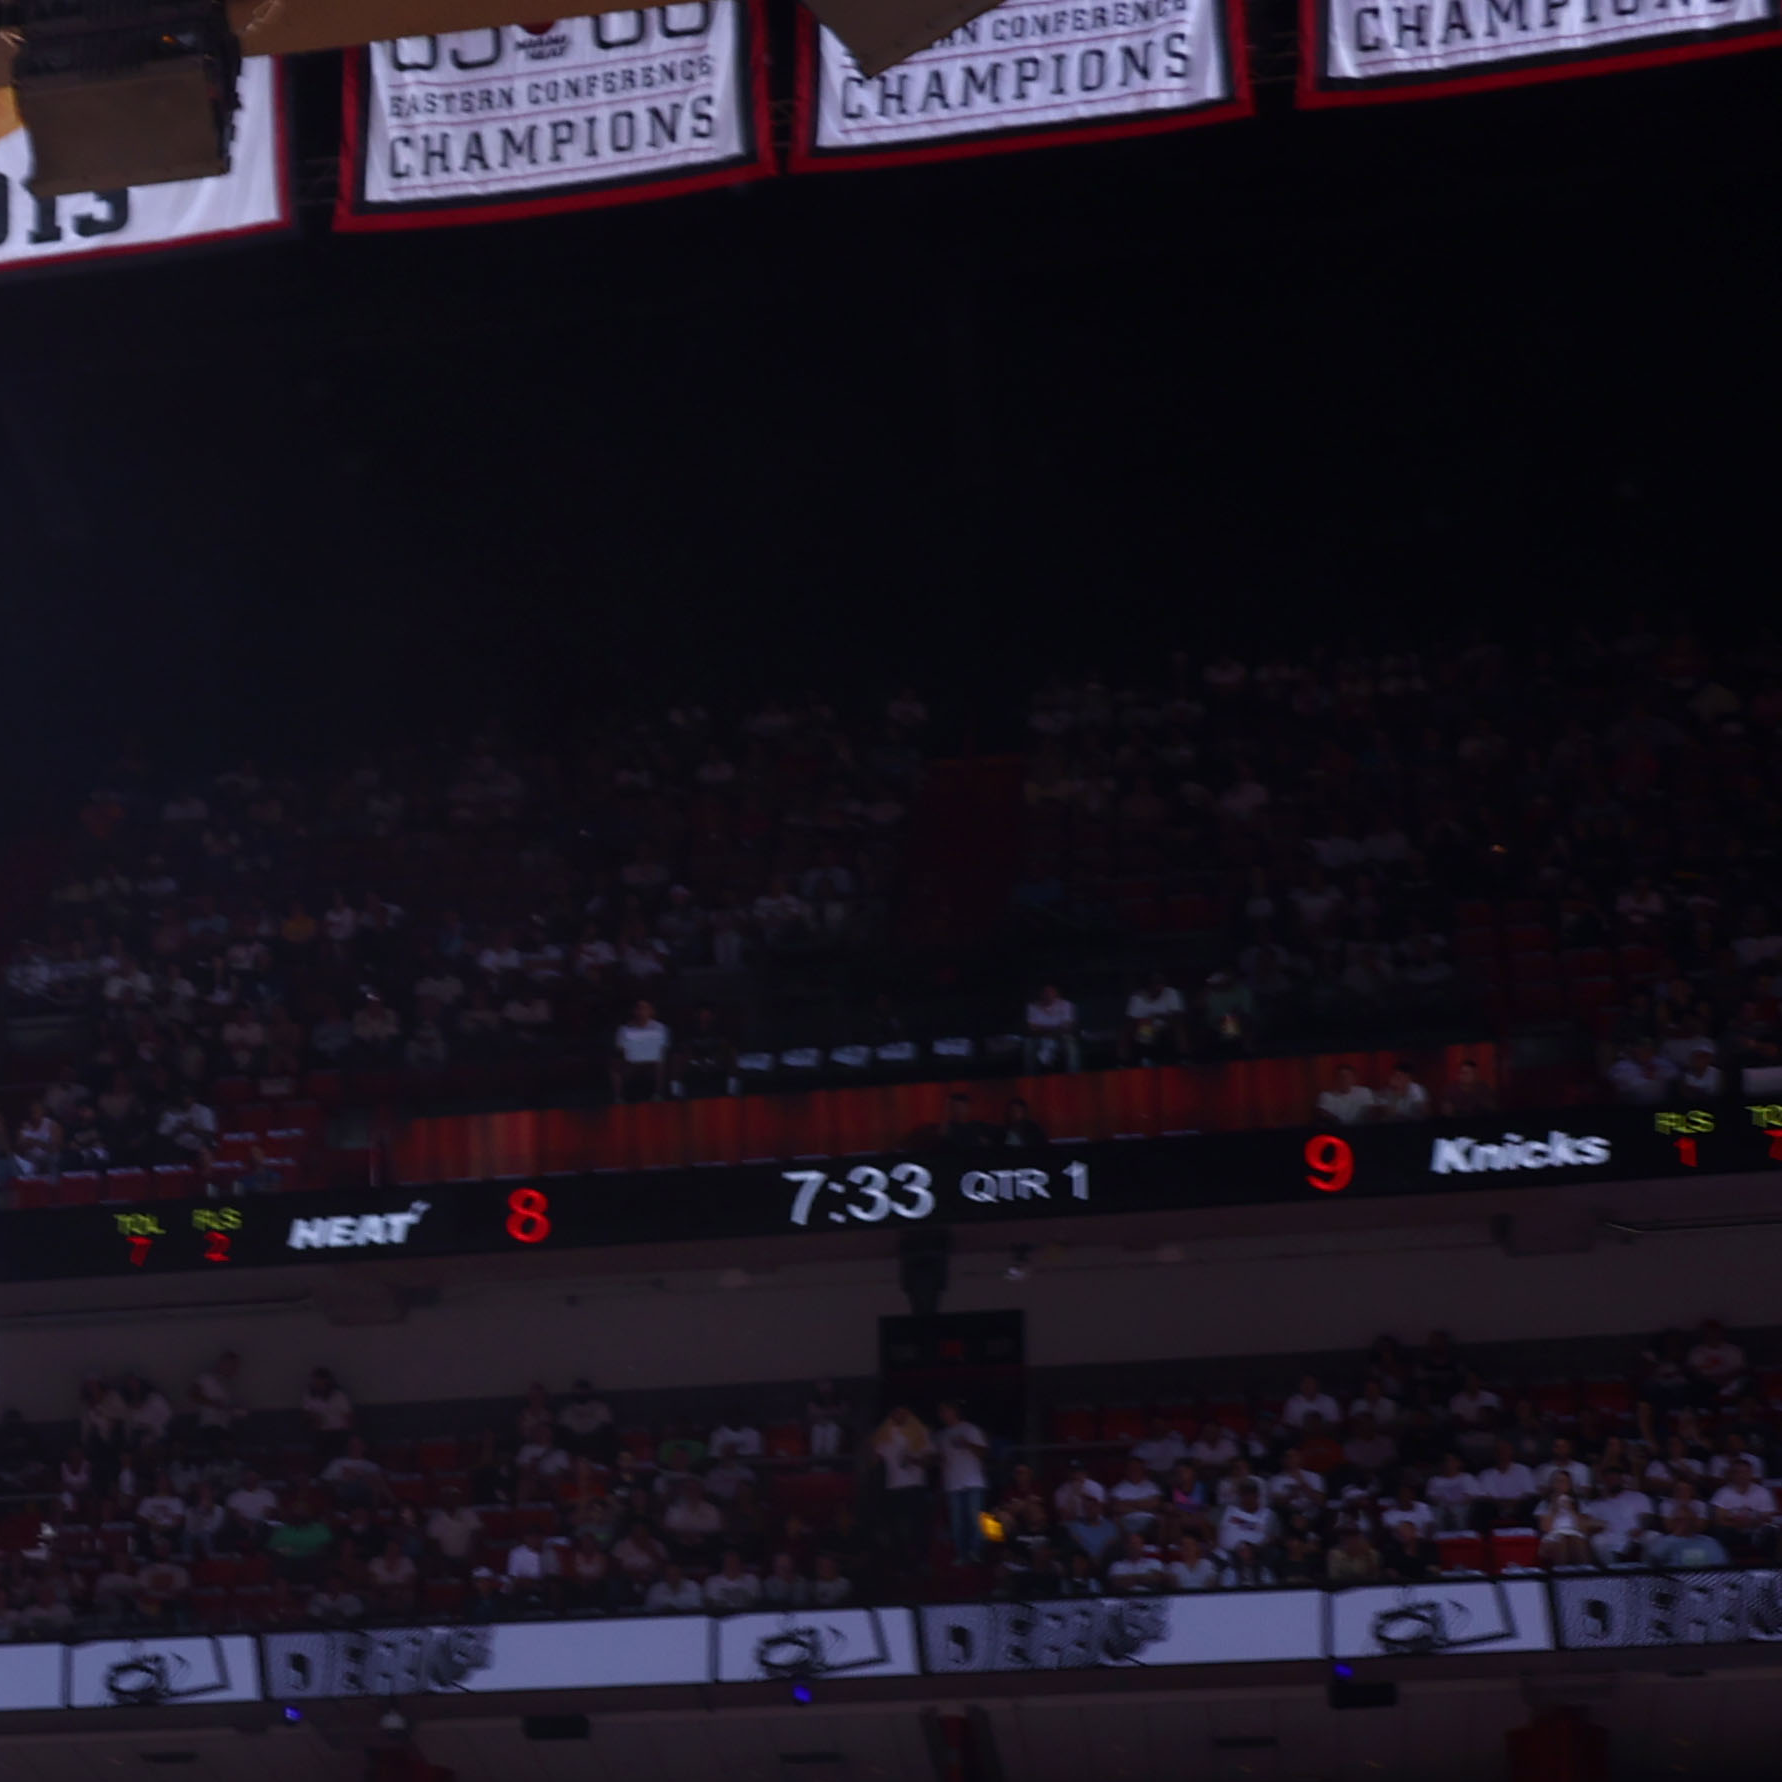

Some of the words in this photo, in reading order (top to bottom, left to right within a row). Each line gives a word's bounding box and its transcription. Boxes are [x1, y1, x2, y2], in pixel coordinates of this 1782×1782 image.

[389, 86, 515, 119] EASTERN
[525, 54, 716, 106] CONFERENCE
[840, 31, 1192, 121] CHAMPIONS
[390, 95, 716, 180] CHAMPIONS
[1303, 1133, 1355, 1194] 9
[1431, 1129, 1612, 1177] Knicks
[1673, 1136, 1699, 1168] 1
[505, 1187, 550, 1245] 8
[782, 1163, 935, 1226] 7:33
[959, 1166, 1051, 1206] QTR
[1063, 1159, 1090, 1201] 1
[203, 1230, 232, 1263] 2
[289, 1200, 433, 1250] HEAT
